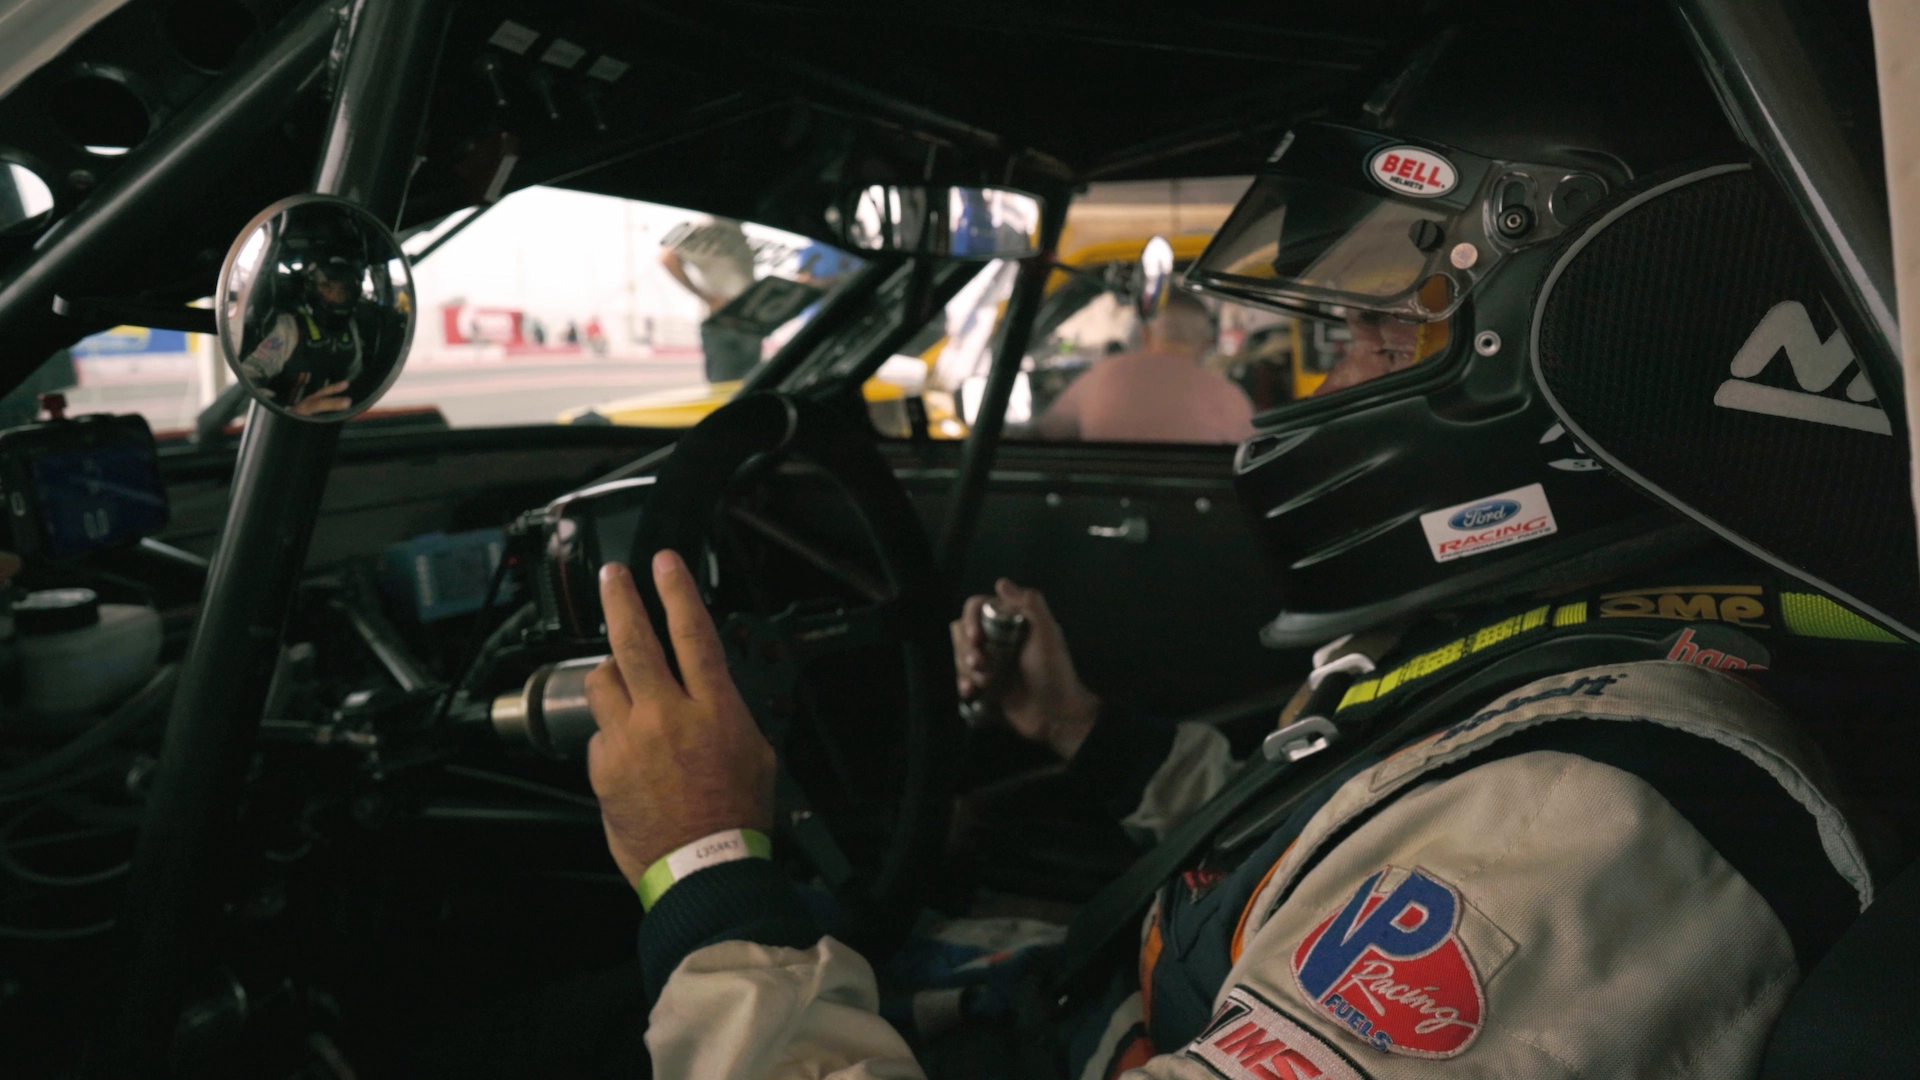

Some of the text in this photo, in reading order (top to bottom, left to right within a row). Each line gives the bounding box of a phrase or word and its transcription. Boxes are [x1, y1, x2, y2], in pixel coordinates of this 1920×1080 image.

[1389, 175, 1424, 190] HELMETS
[1439, 516, 1547, 553] RACING
[1463, 505, 1506, 527] Ford
[1600, 592, 1770, 629] OMP
[1298, 868, 1456, 1000] VP
[1338, 959, 1478, 1034] Racing
[1324, 994, 1394, 1052] FUELS
